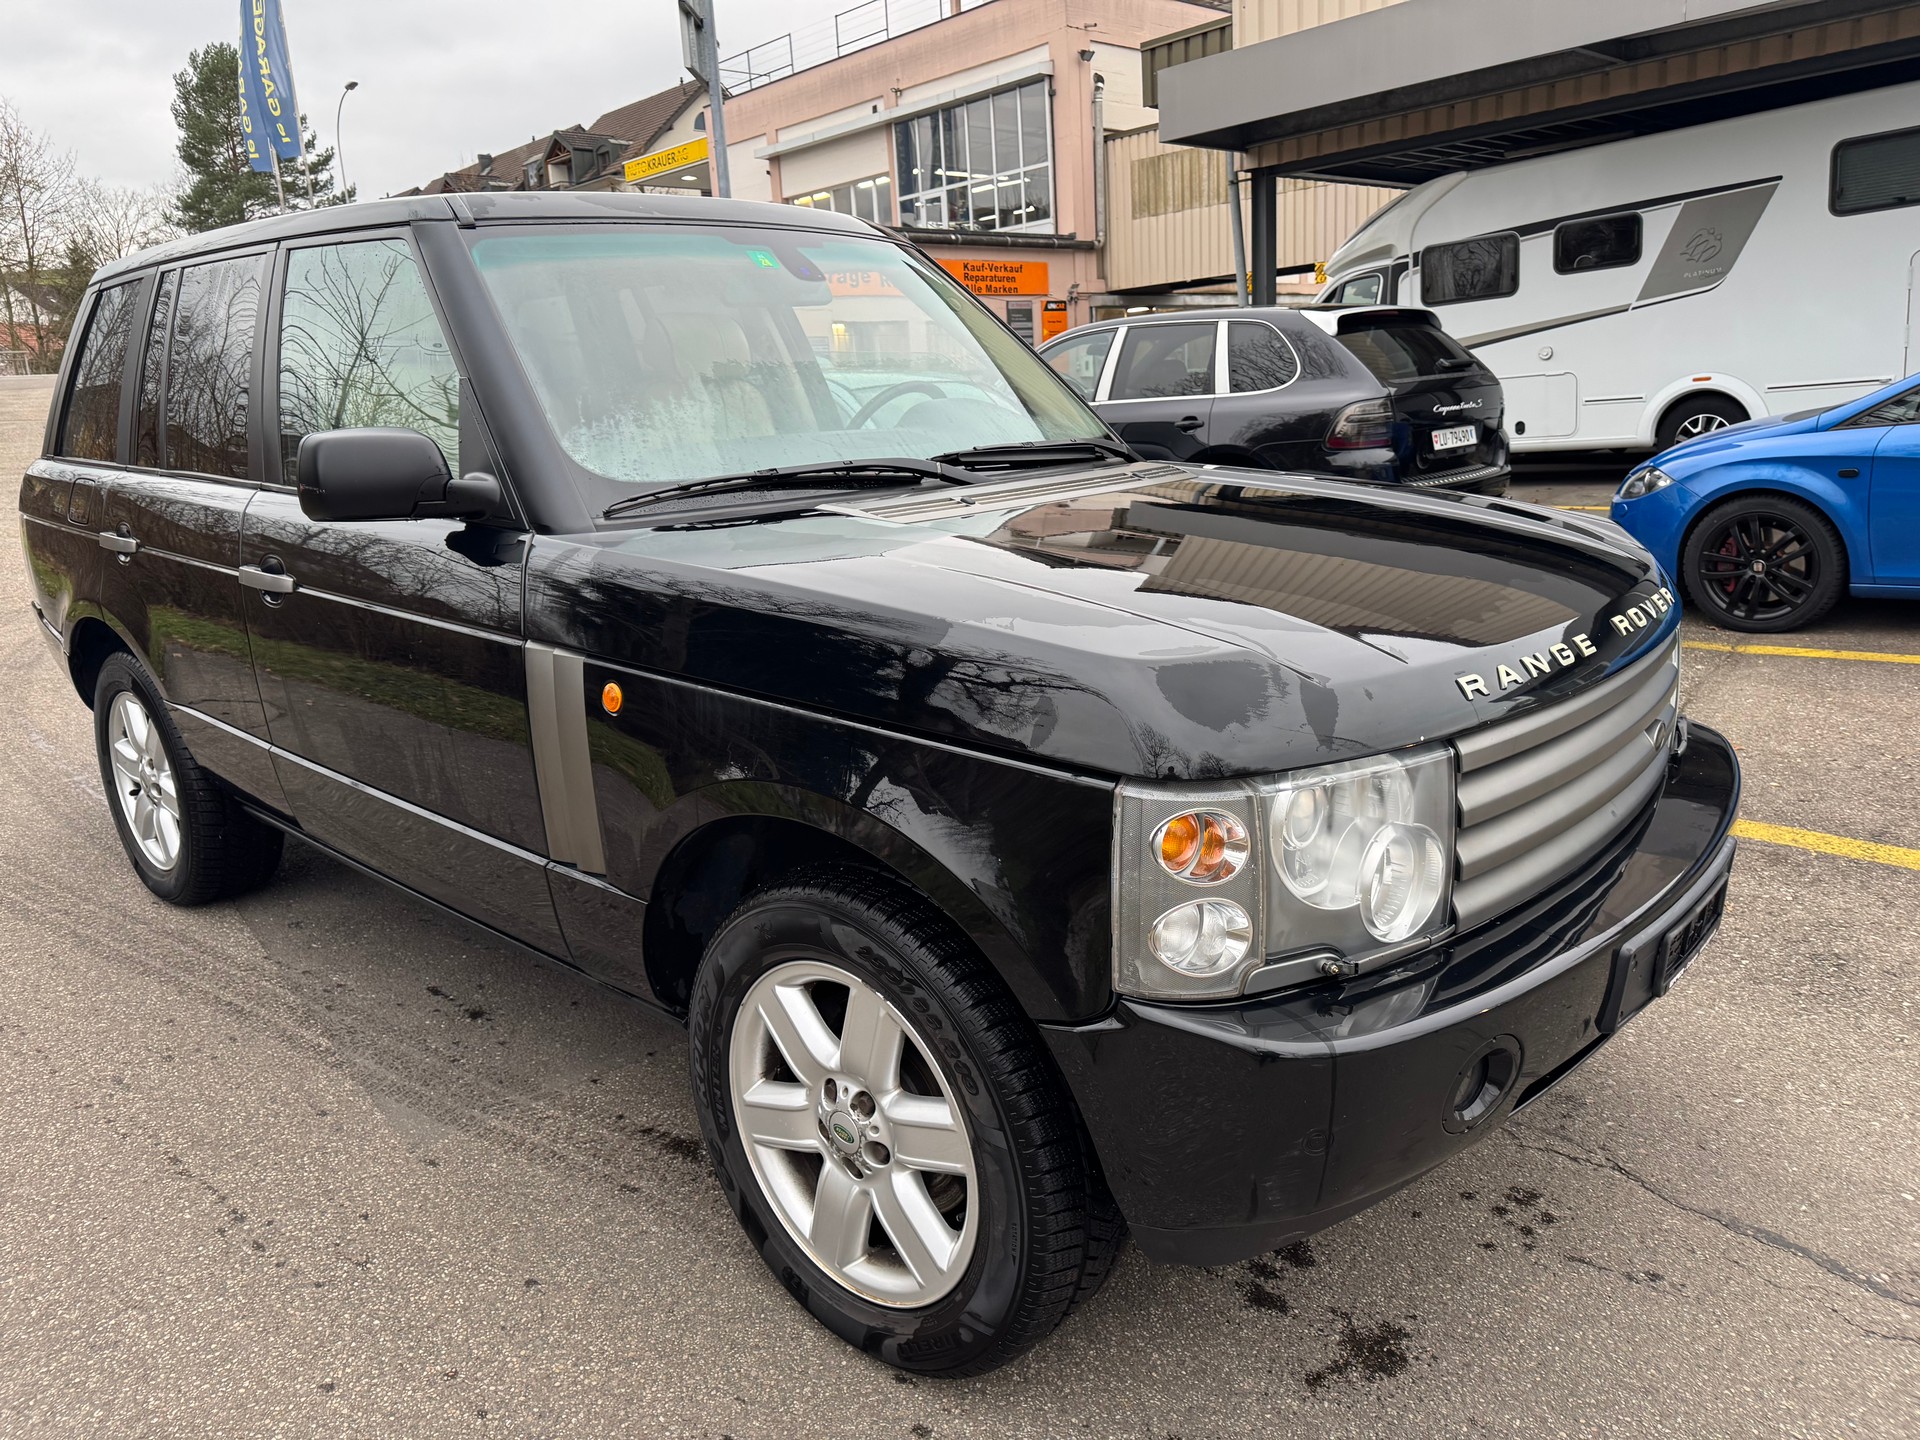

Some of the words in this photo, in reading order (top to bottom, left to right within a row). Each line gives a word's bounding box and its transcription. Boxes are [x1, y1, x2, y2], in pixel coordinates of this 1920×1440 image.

[963, 262, 1023, 273] Kauf-Verkauf
[963, 272, 1016, 283] Reparaturen
[985, 284, 1018, 293] Marken
[1455, 633, 1597, 701] RANGE
[1610, 587, 1676, 637] ROVER
